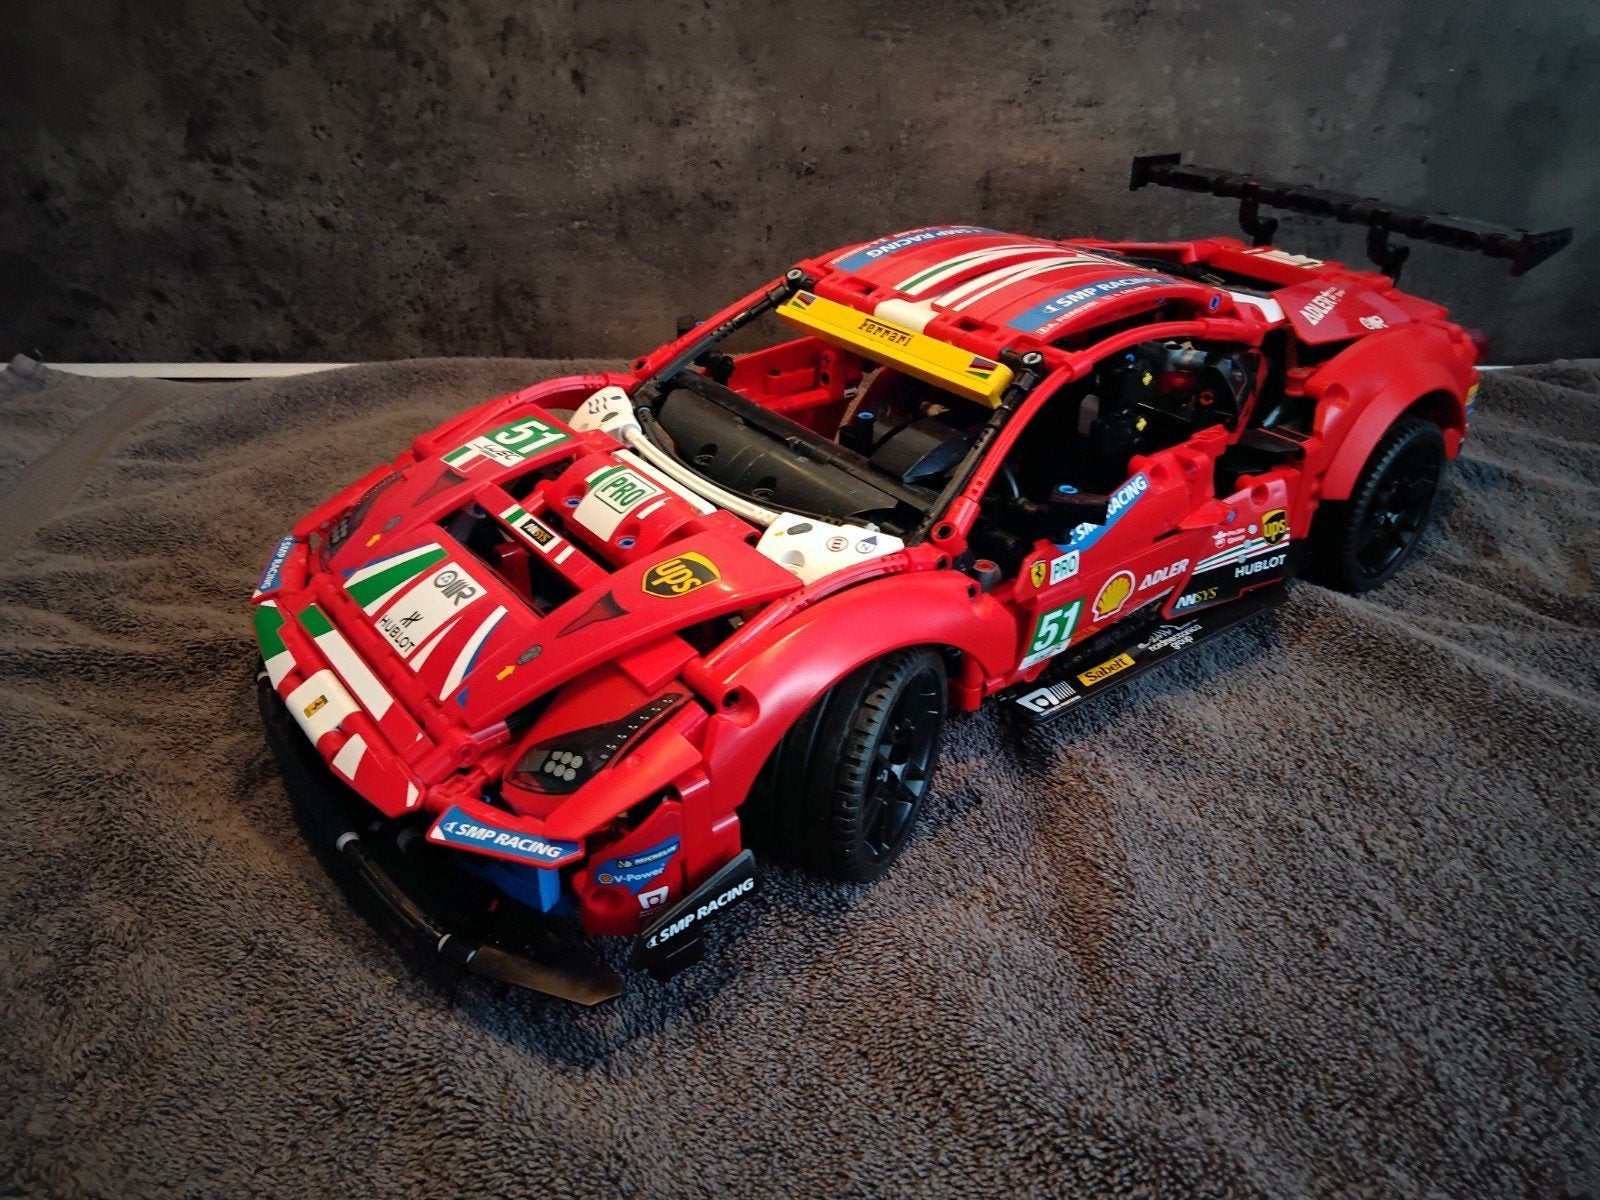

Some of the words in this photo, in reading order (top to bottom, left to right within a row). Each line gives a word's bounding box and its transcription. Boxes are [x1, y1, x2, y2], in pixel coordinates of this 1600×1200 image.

[866, 232, 935, 258] RACING
[1057, 287, 1098, 307] SMP
[1299, 295, 1338, 326] ADLER
[858, 318, 914, 346] Ferrari
[495, 421, 567, 454] 51
[600, 476, 647, 507] PRO
[1106, 475, 1148, 518] ACING
[1053, 555, 1077, 580] PRO
[1138, 558, 1190, 591] ADLER
[1235, 554, 1287, 578] HUBLOT
[1176, 587, 1219, 609] ANSYS
[378, 614, 415, 653] HUBLOT
[1033, 600, 1080, 651] 51
[1085, 657, 1129, 681] Sabelt
[455, 822, 496, 841] SMP
[496, 832, 563, 859] RACING
[613, 866, 664, 882] V-Power
[659, 912, 695, 942] SMP
[697, 877, 755, 920] RACING
